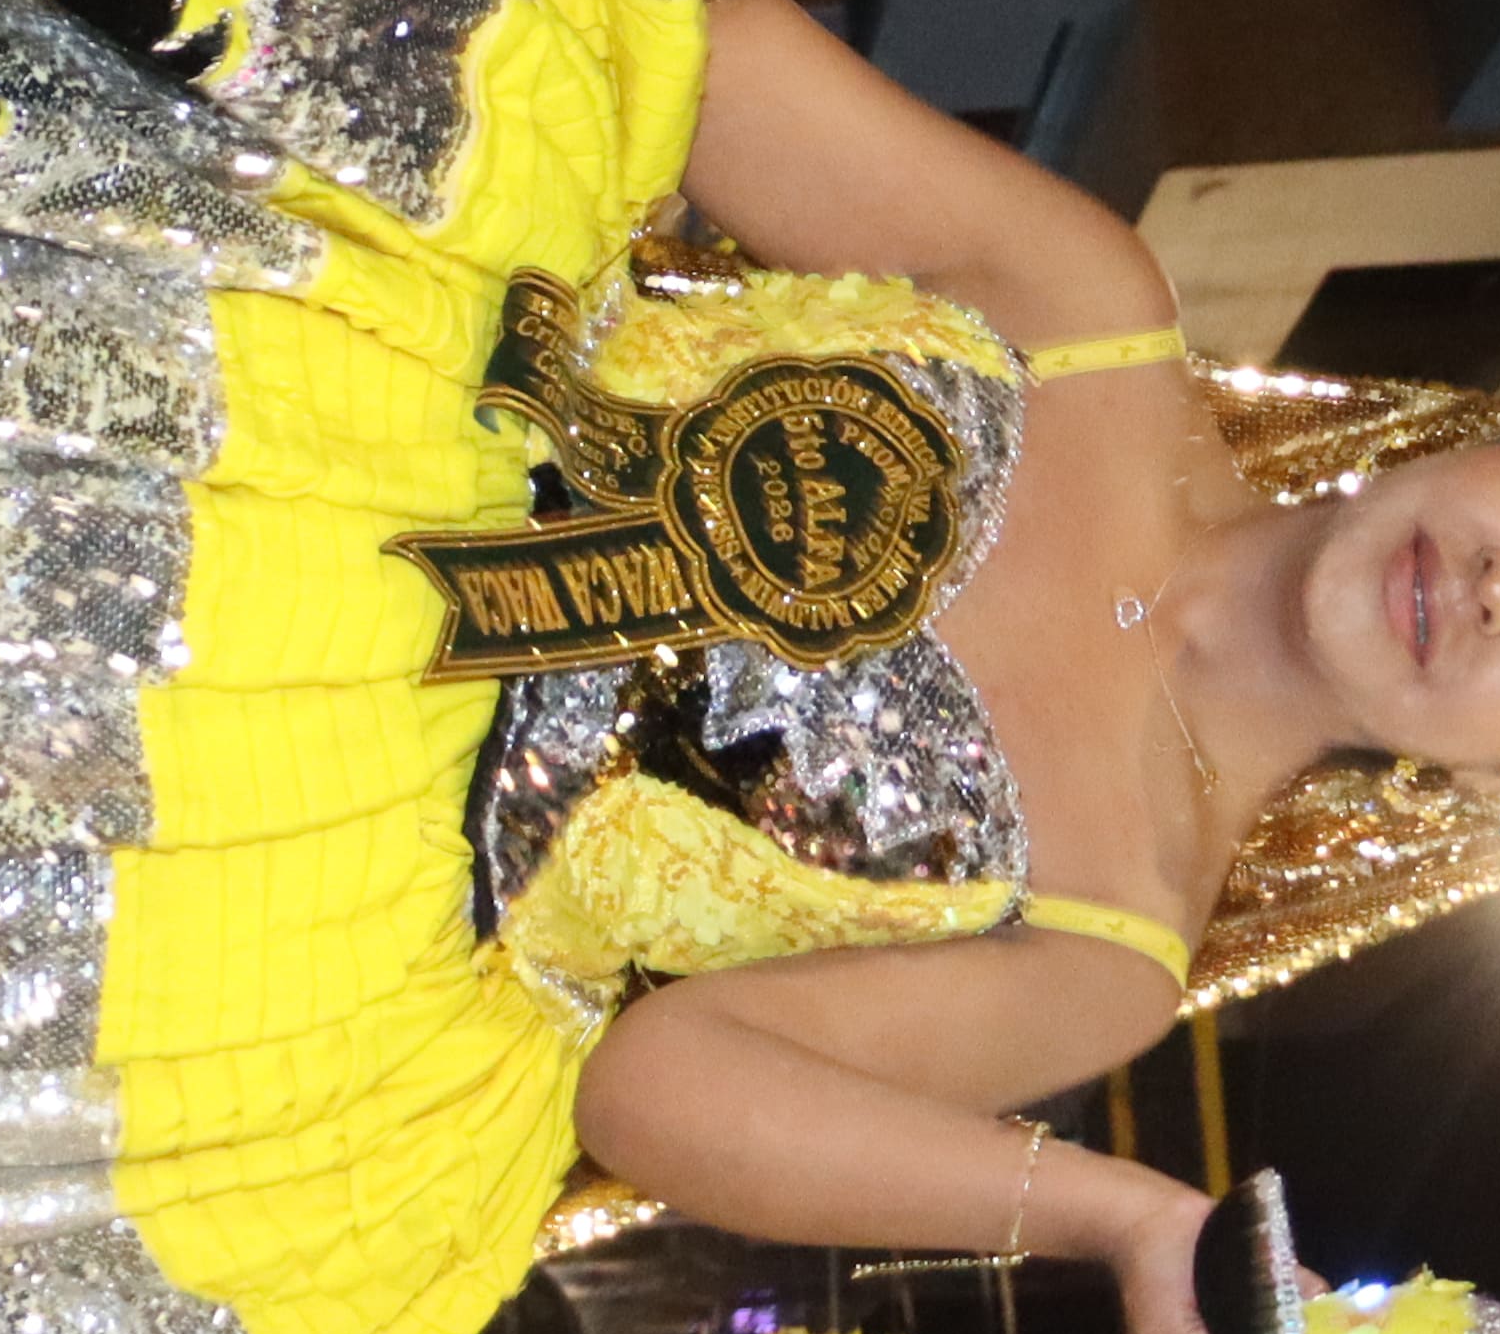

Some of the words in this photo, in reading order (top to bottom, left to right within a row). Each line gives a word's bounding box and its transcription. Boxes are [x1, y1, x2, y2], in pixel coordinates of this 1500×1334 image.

[780, 413, 826, 470] 5to
[874, 403, 945, 526] EDUCAIVA
[753, 458, 793, 544] 2026
[799, 479, 846, 590] ALFA
[455, 566, 570, 638] WACA
[556, 545, 693, 625] WACA
